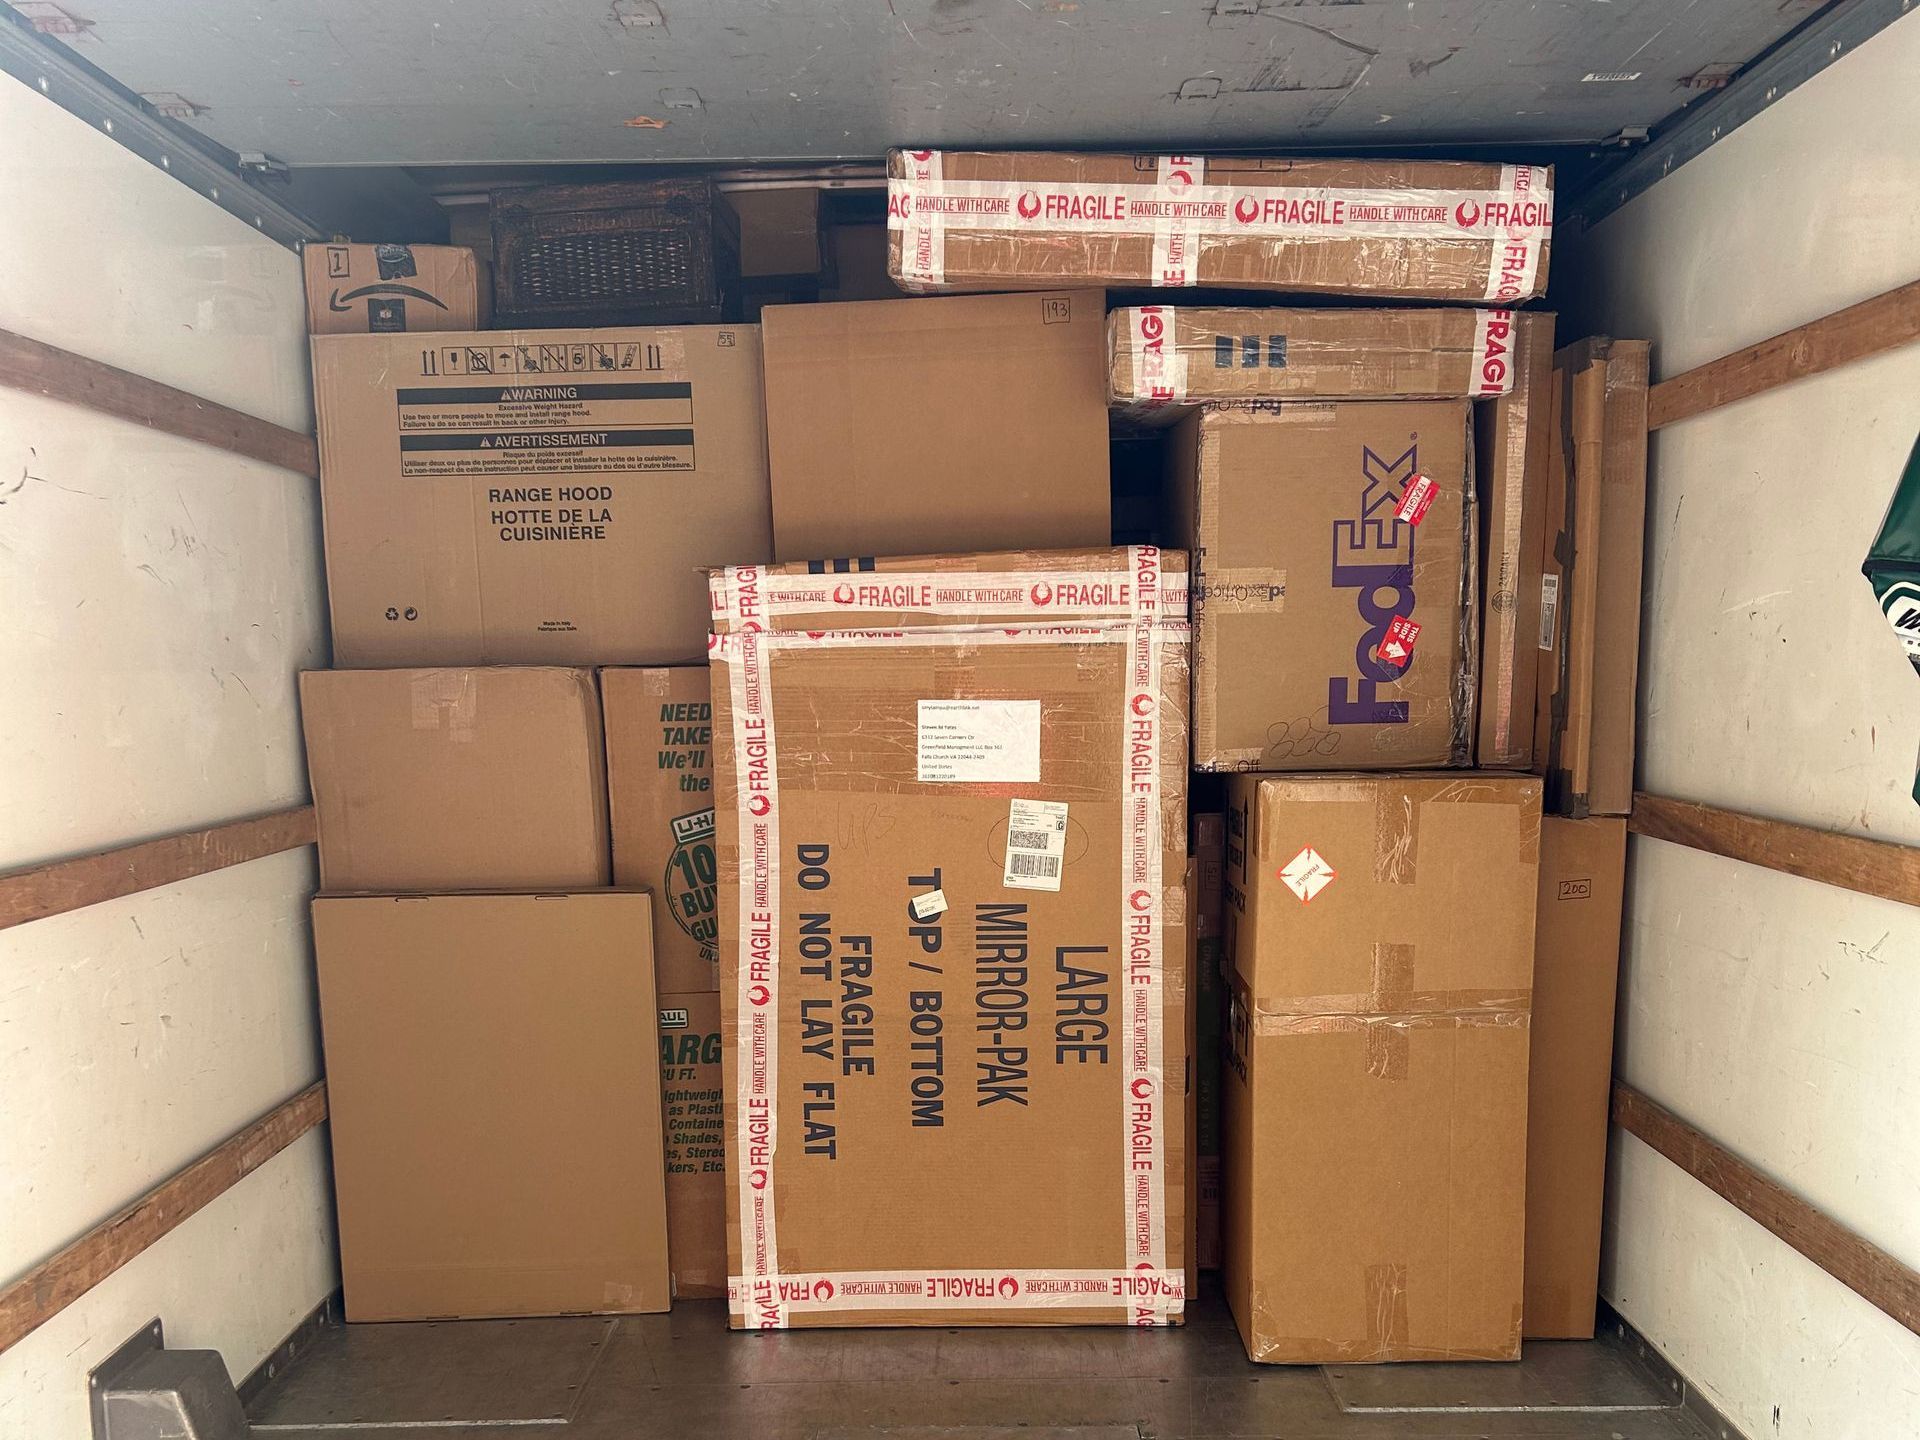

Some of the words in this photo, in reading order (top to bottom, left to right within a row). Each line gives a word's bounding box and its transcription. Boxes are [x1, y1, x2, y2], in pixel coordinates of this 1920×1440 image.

[915, 197, 954, 213] HANDLE
[1045, 194, 1126, 220] FRAGILE
[1130, 202, 1170, 216] HANDLE
[1263, 199, 1344, 225] FRAGILE
[1350, 206, 1390, 221] HANDLE
[1046, 301, 1068, 319] 193
[511, 387, 577, 401] WARNING
[494, 433, 608, 448] AVERTISSEMENT
[489, 487, 553, 503] RANGE
[558, 486, 613, 502] HOOD
[1403, 482, 1427, 516] FRAGILE
[491, 509, 552, 525] HOTTE
[558, 508, 583, 524] DE
[588, 508, 613, 523] LA
[499, 522, 606, 542] CUISINIÈRE
[1056, 584, 1129, 606] FRAGILE
[1327, 443, 1417, 725] FedEx
[858, 585, 932, 607] FRAGILE
[936, 589, 972, 602] HANDLE
[1393, 621, 1401, 634] UP
[1398, 622, 1411, 640] SIDE
[1406, 626, 1420, 644] THIS
[747, 676, 760, 714] HANDLE
[663, 726, 712, 746] TAKE
[657, 750, 705, 770] We'll
[746, 718, 770, 792] FRAGILE
[1131, 720, 1152, 792] FRAGILE
[679, 773, 710, 792] the
[1135, 797, 1146, 833] HANDLE
[797, 844, 831, 890] DO
[1295, 864, 1320, 887] FRAGILE
[755, 874, 767, 908] HANDLE
[1562, 882, 1588, 895] 200
[751, 912, 772, 982] FRAGILE
[799, 913, 832, 981] NOT
[1130, 915, 1151, 985] FRAGILE
[839, 935, 874, 1076] FRAGILE
[975, 903, 1028, 1106] MIRROR-PAK
[1055, 946, 1109, 1064] LARGE
[1135, 989, 1147, 1023] HANDLE
[801, 1000, 834, 1060] LAY
[910, 990, 944, 1127] BOTTOM
[678, 1068, 697, 1081] FT.
[754, 1060, 765, 1094] HANDLE
[668, 1106, 683, 1116] as
[803, 1082, 836, 1160] FLAT
[673, 1132, 722, 1146] Shades,
[749, 1098, 770, 1166] FRAGILE
[1131, 1102, 1152, 1171] FRAGILE
[1137, 1174, 1149, 1209] HANDLE
[888, 1281, 922, 1294] HANDLE
[926, 1277, 995, 1298] FRAGILE
[1072, 1280, 1108, 1293] HANDLE
